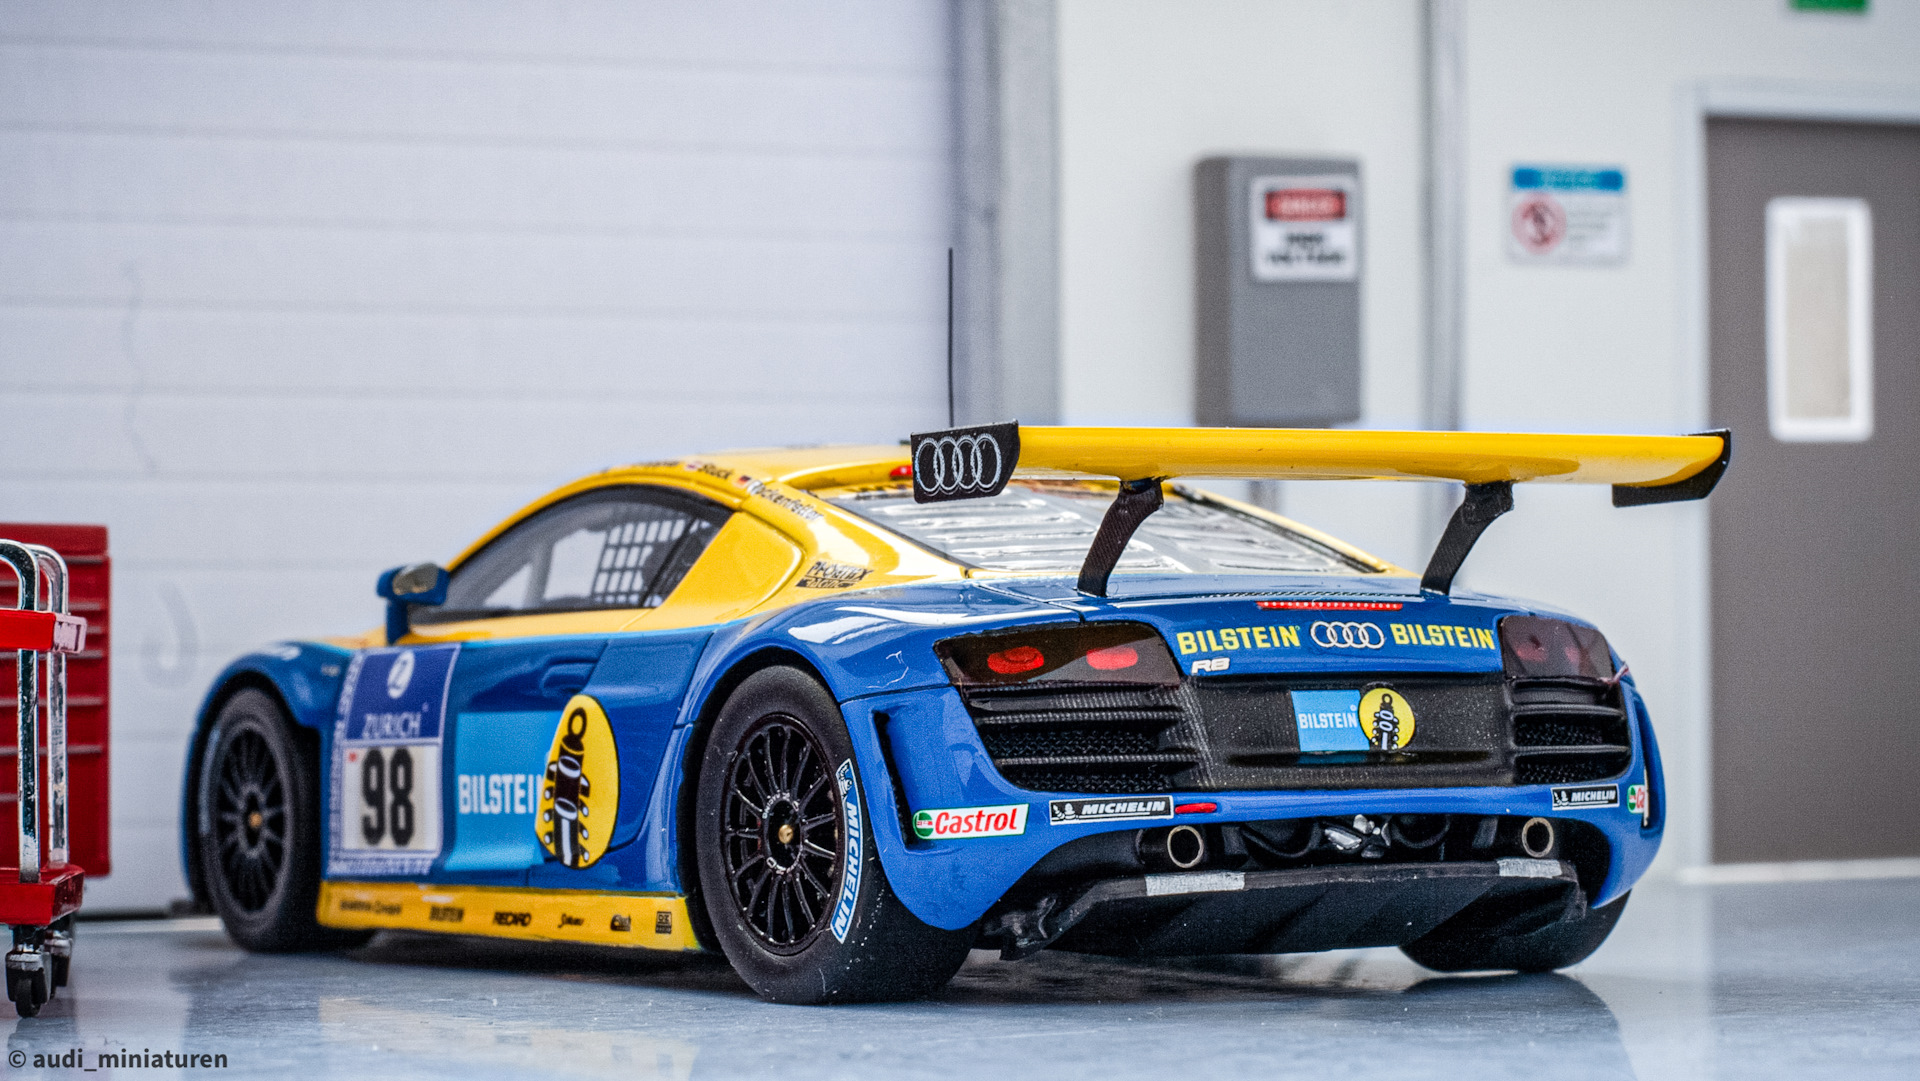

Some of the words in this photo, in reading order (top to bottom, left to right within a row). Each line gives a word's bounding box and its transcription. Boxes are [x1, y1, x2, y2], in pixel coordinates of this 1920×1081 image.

[1176, 625, 1300, 655] BILSTEIN
[1390, 623, 1496, 649] BILSTEIN
[1191, 657, 1230, 674] R8
[1298, 712, 1358, 729] BILSTEIN
[362, 745, 415, 847] 98
[1081, 801, 1166, 815] MICHELIN
[1571, 790, 1616, 802] MICHELIN
[935, 808, 1017, 835] Castrol
[832, 801, 860, 935] MICHELIN
